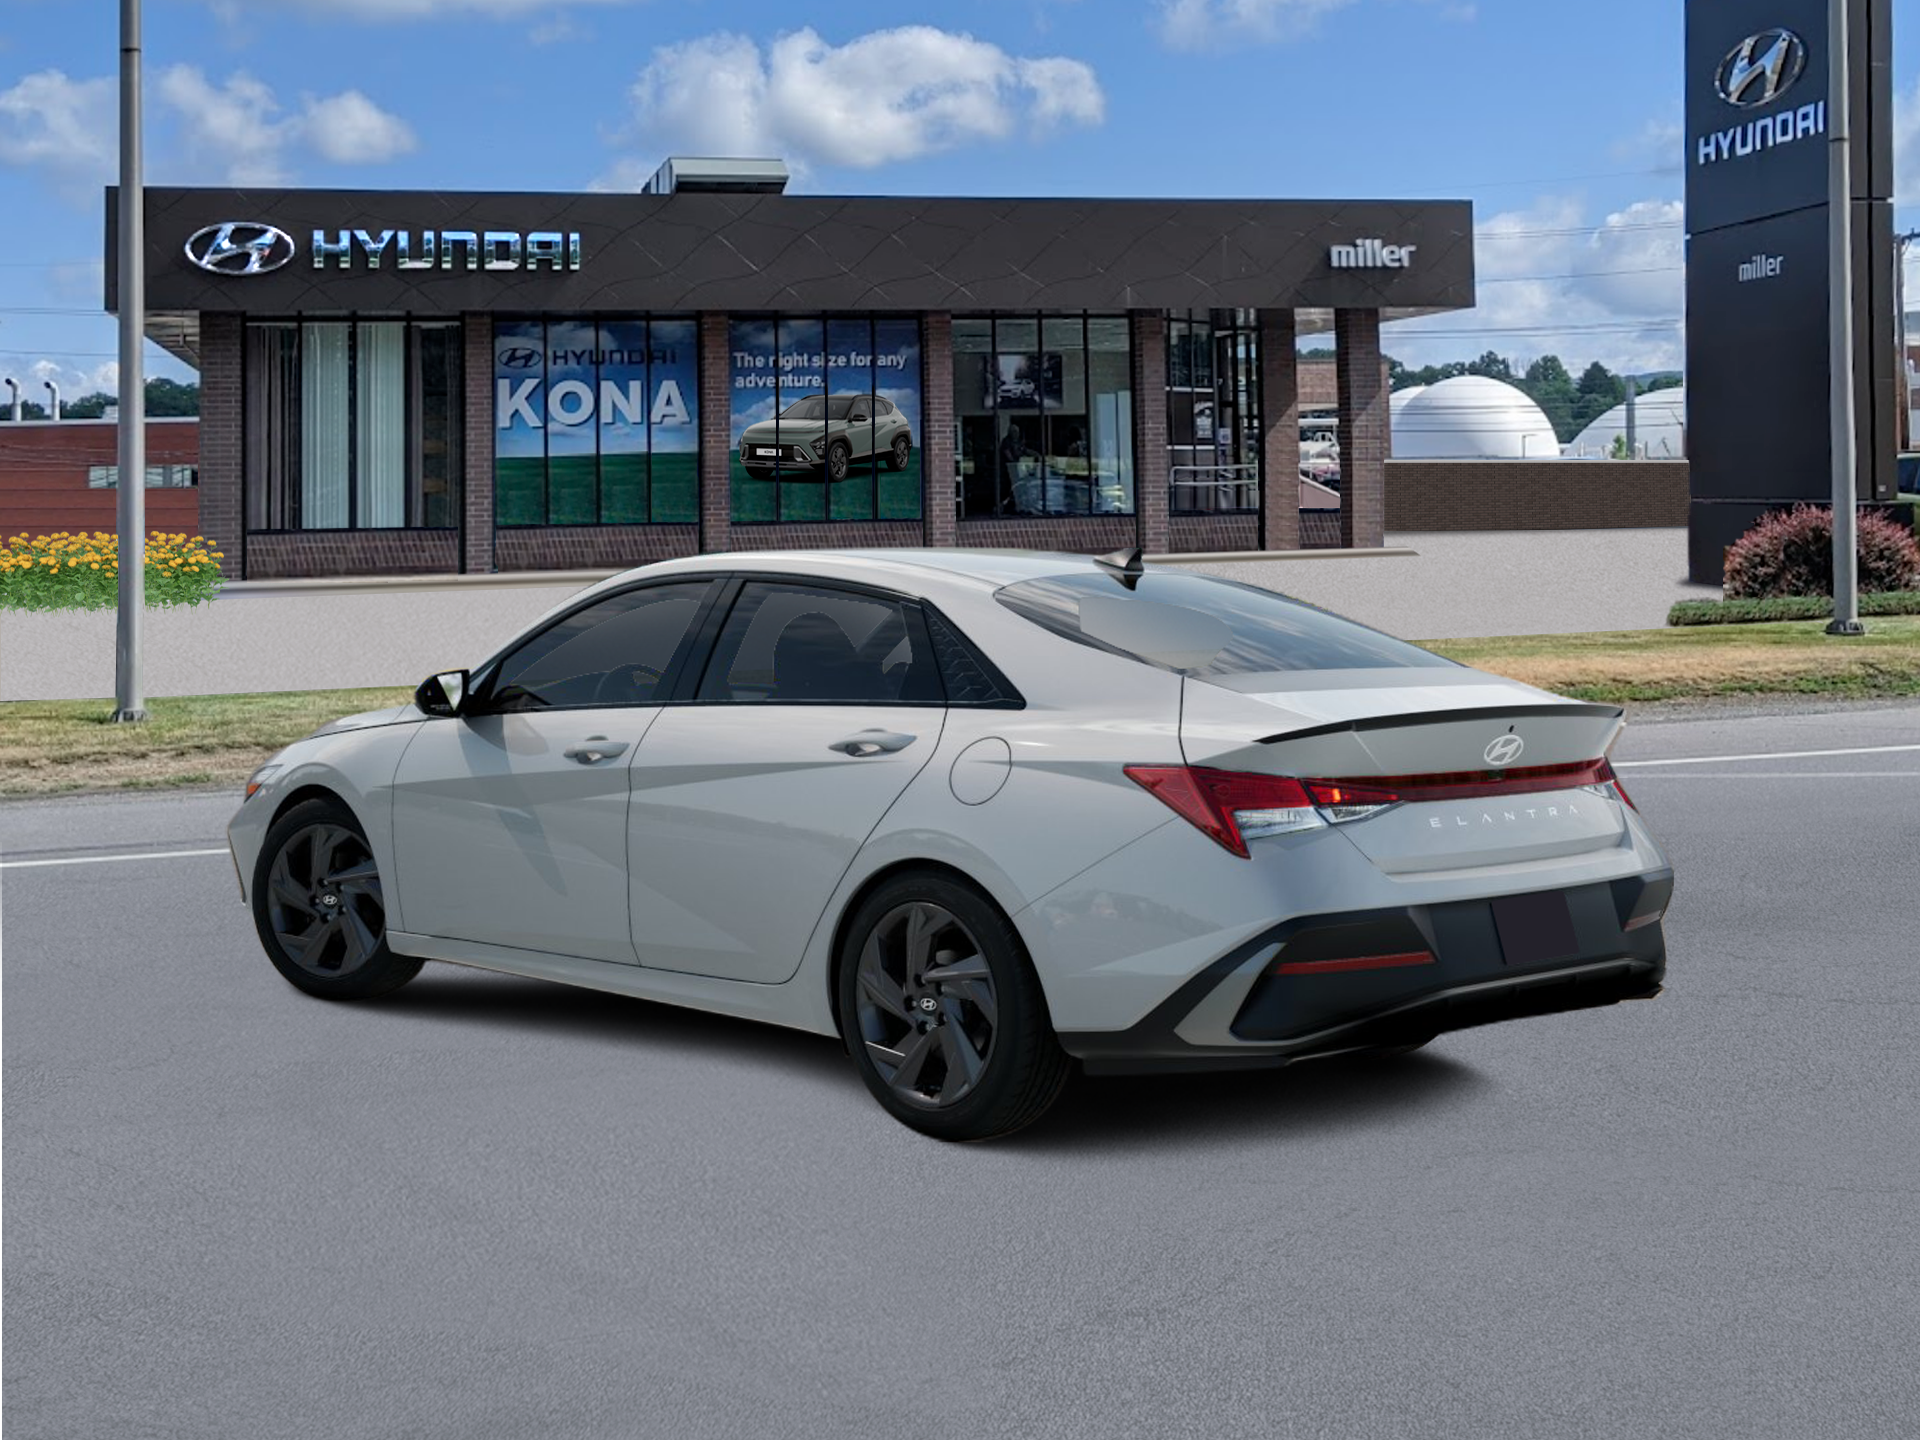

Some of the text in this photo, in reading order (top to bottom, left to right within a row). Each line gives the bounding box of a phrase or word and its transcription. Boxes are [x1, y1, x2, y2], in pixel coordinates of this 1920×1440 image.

[1698, 101, 1825, 165] HYUNDAI
[312, 229, 581, 271] HYUNDAI
[1330, 238, 1417, 268] miller
[1738, 254, 1784, 282] miller
[552, 350, 678, 366] HYUNDAI
[733, 351, 907, 371] The right size for any
[735, 372, 826, 388] adventure.
[497, 377, 691, 430] KONA
[1429, 804, 1579, 828] ELANTRA
